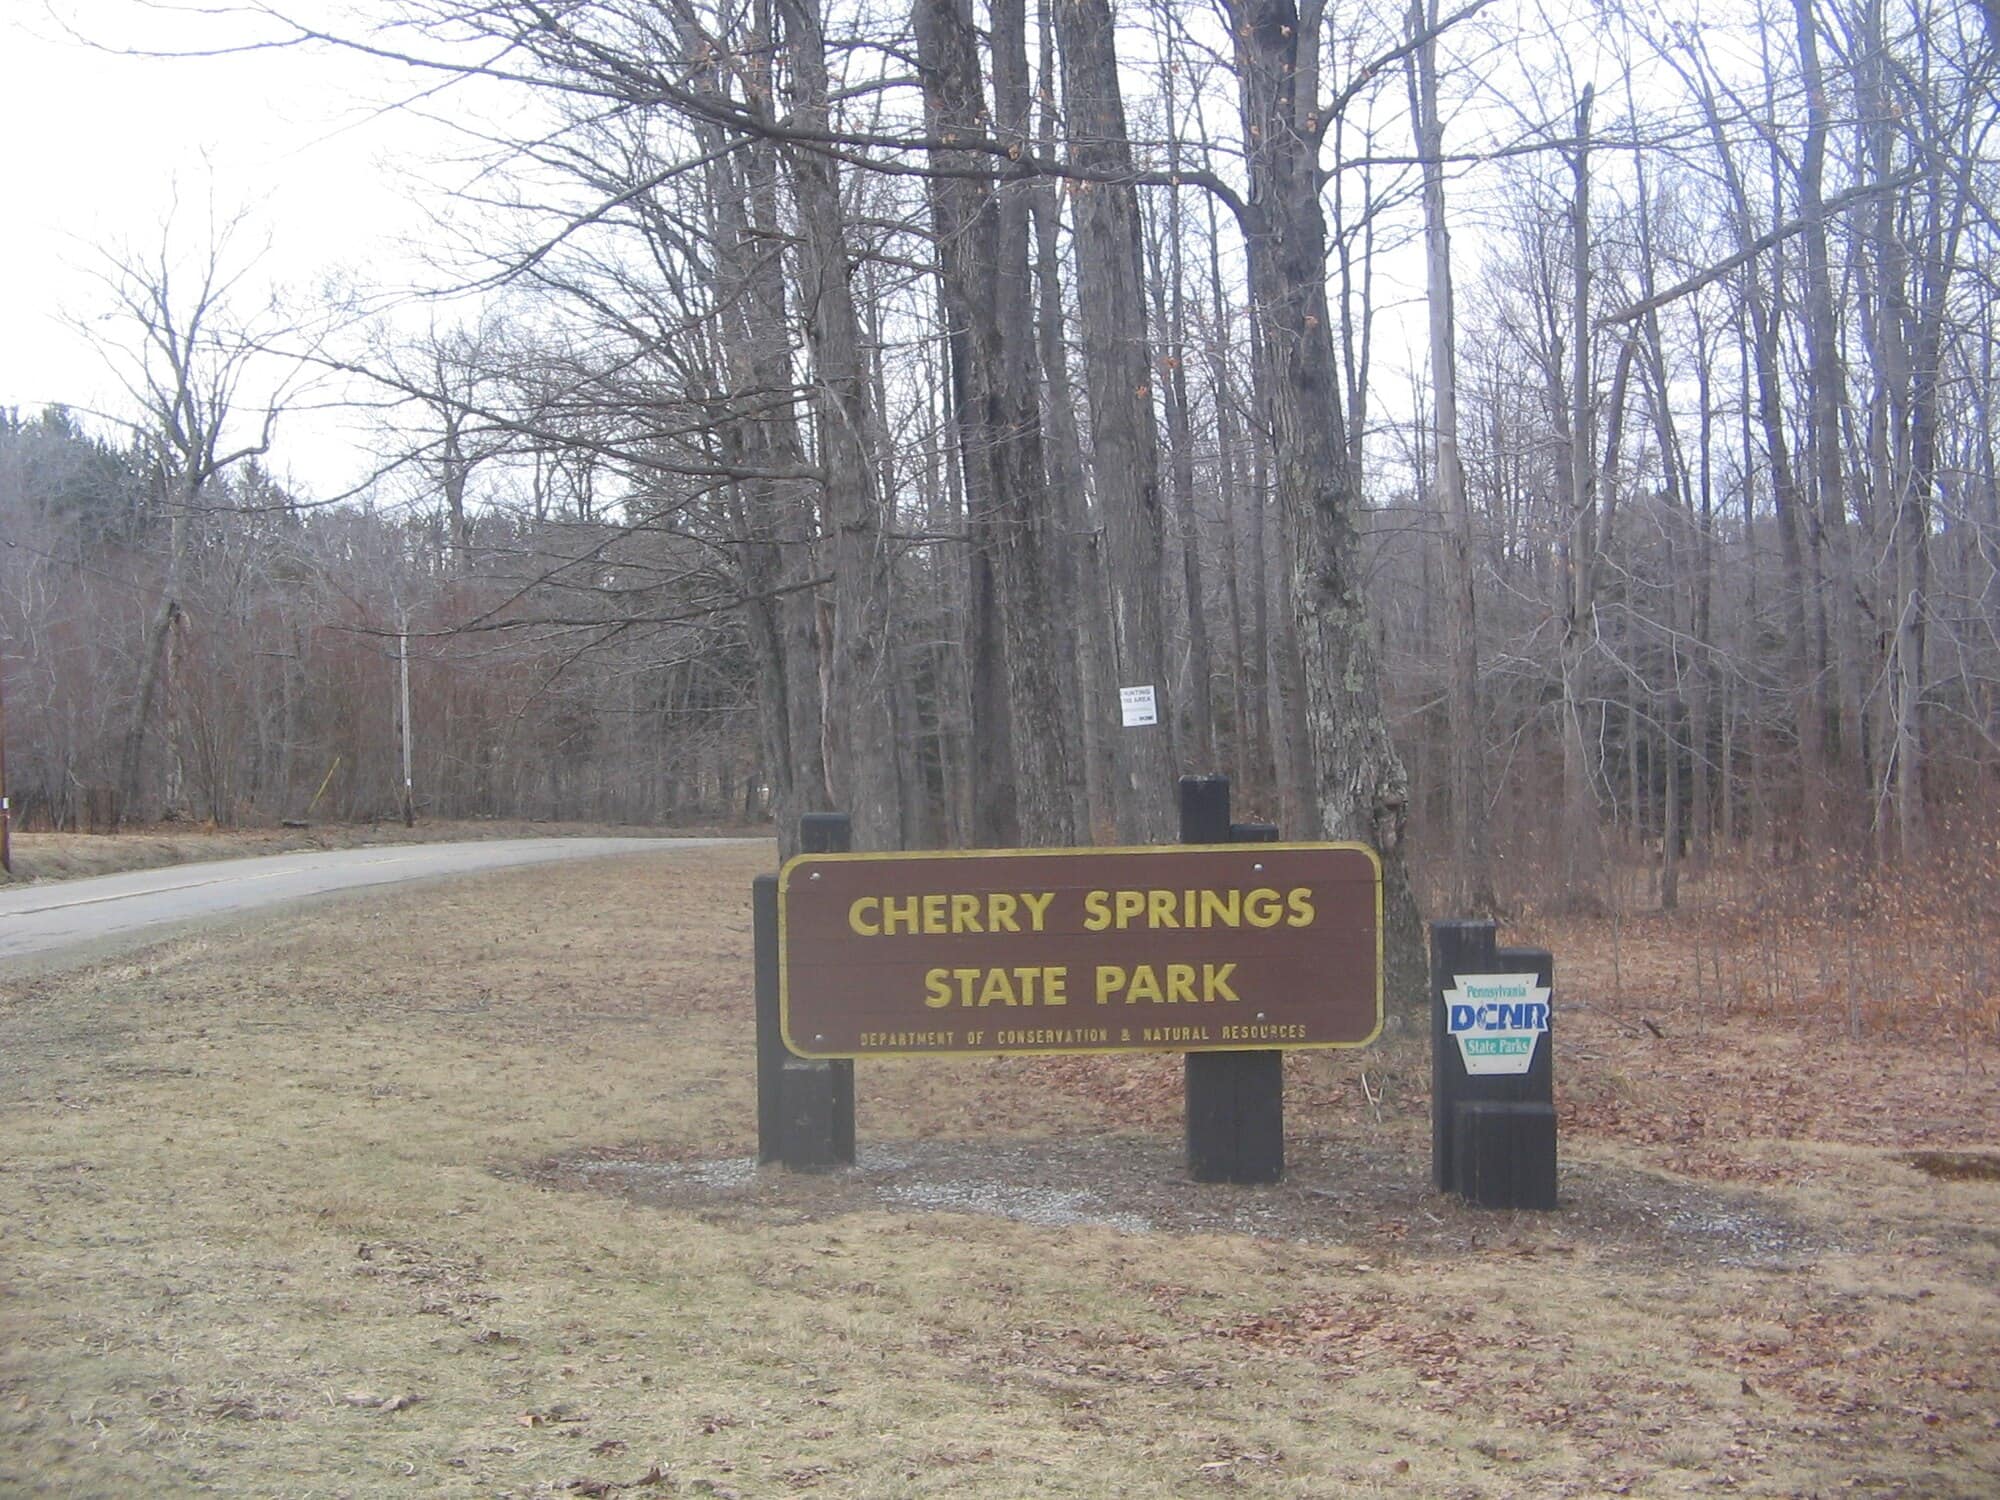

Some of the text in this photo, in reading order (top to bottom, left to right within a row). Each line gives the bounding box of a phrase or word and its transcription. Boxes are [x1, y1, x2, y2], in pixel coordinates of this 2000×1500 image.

[848, 888, 1315, 936] CHERRY SPRINGS
[925, 963, 1240, 1008] STATE PARK
[1467, 984, 1526, 999] Pennsylvania
[1451, 1003, 1547, 1031] DCNR
[860, 1025, 1307, 1047] DEPARTMENT OF CONSERVATION & NATURAL RESOURCES
[1468, 1039, 1528, 1053] State Parks
